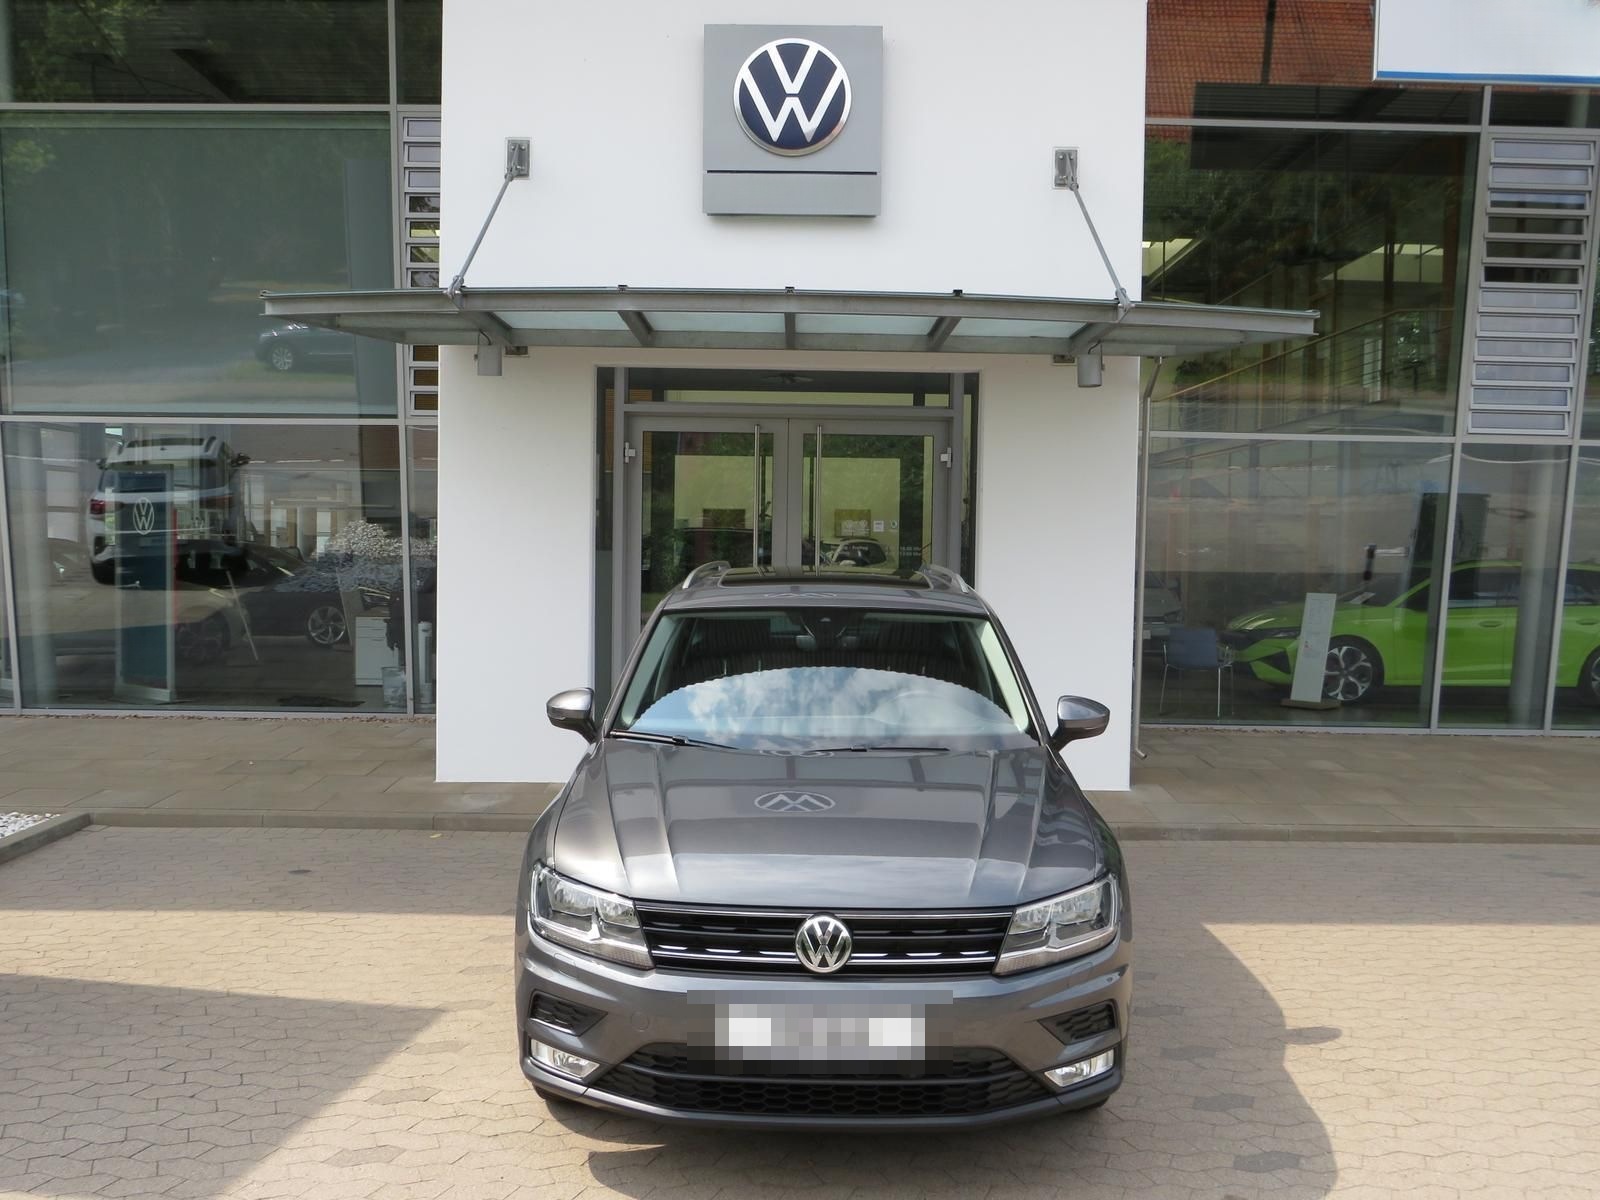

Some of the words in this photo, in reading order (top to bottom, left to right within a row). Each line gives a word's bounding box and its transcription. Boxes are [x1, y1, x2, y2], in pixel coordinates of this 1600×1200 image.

[736, 40, 849, 151] VW
[133, 498, 154, 534] VW
[798, 917, 850, 971] VW
